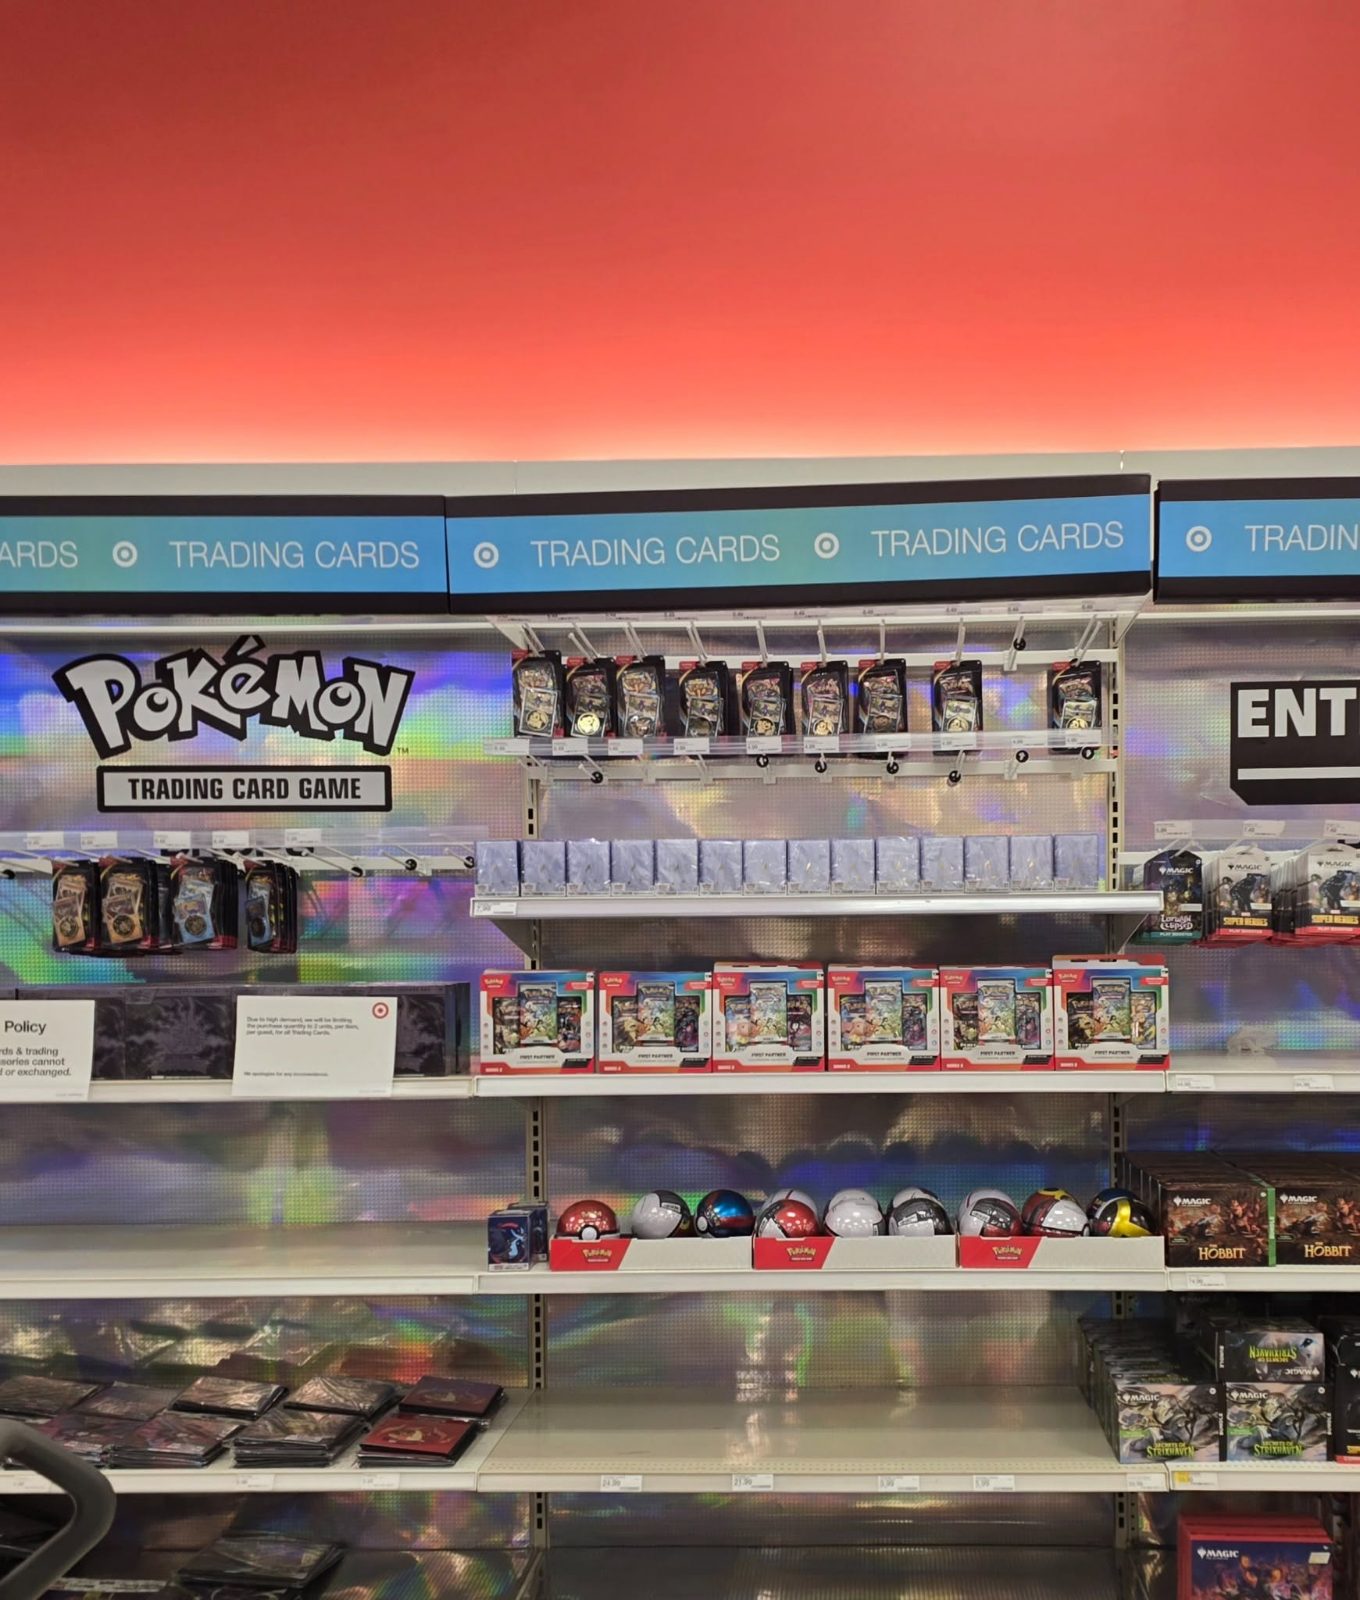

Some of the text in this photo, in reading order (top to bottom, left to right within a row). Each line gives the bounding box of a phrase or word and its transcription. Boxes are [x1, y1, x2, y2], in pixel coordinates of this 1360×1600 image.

[870, 520, 1124, 558] TRADING CARDS
[1244, 523, 1359, 553] TRADIN
[168, 540, 420, 569] TRADING CARDS
[530, 533, 781, 568] TRADING CARDS
[128, 777, 362, 800] TRADING CARD GAME
[4, 1020, 47, 1036] Policy
[15, 1047, 23, 1056] &
[25, 1047, 59, 1057] trading
[31, 1057, 66, 1067] cannot
[4, 1069, 15, 1077] or
[17, 1067, 72, 1078] exchanged.
[1287, 1195, 1318, 1203] MAGIC
[1198, 1247, 1247, 1261] HOBBIT
[1303, 1244, 1353, 1258] HOBBIT
[1239, 1391, 1268, 1399] MAGIC
[1146, 1445, 1195, 1458] STRIXHAVEN
[1254, 1444, 1303, 1457] STRIXHAVEN
[1206, 1549, 1239, 1558] MAGIC
